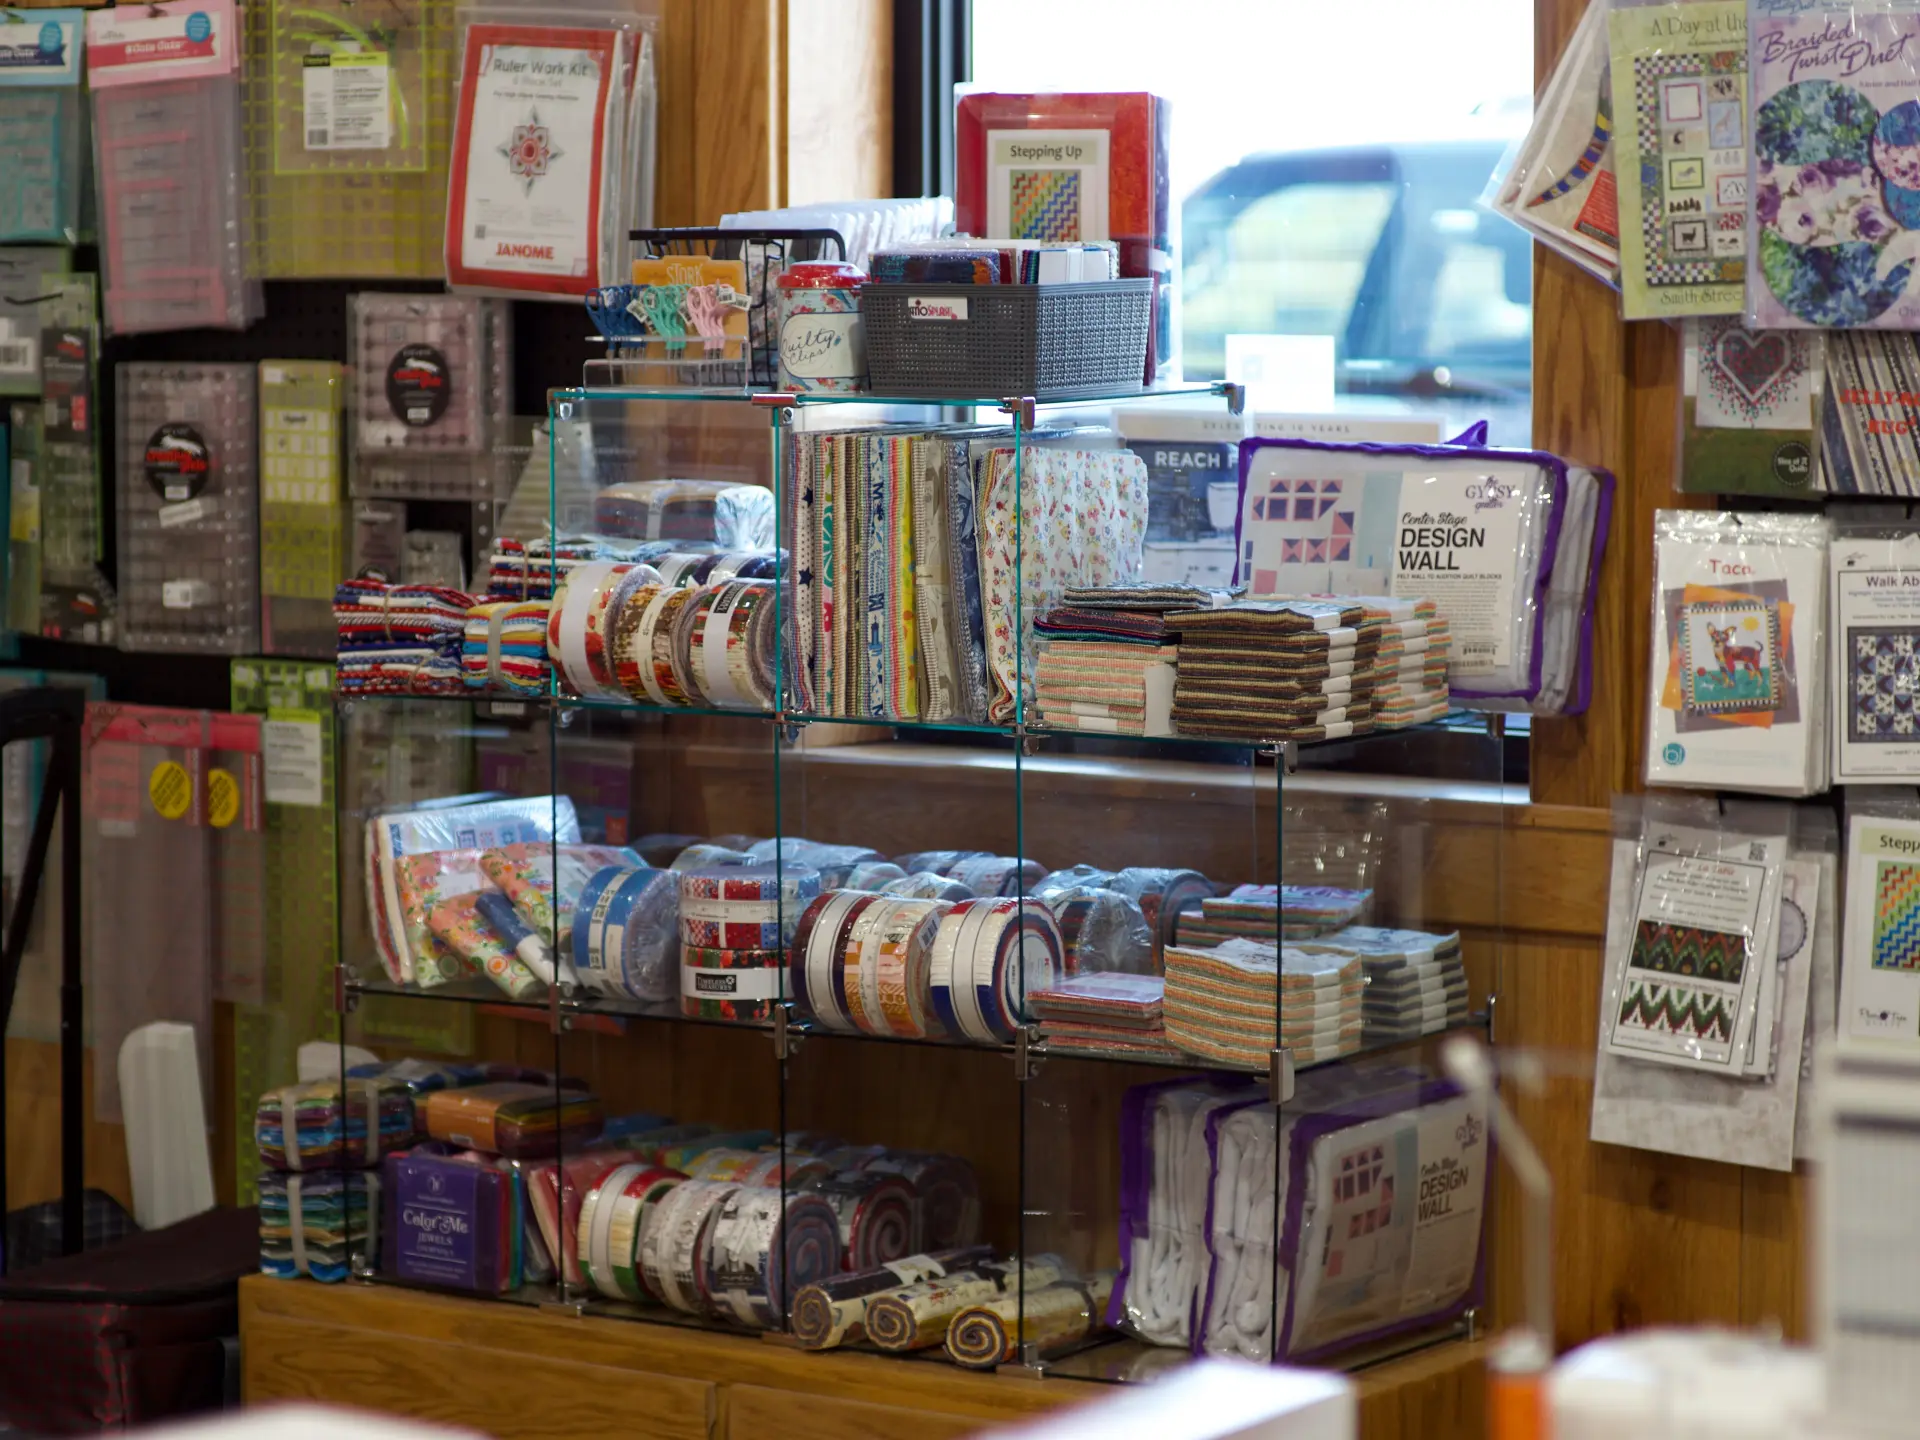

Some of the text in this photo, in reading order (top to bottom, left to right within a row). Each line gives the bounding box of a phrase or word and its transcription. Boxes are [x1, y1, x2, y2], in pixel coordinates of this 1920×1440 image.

[1667, 16, 1699, 37] Day
[1704, 17, 1721, 32] at
[1758, 20, 1854, 64] Braided
[493, 58, 588, 76] Ruler Work Kit
[1781, 33, 1915, 82] Twist Duet
[1010, 145, 1083, 161] Stepping Up
[496, 242, 554, 260] JANOME
[667, 263, 704, 286] STORK
[781, 328, 835, 359] Quilty
[1155, 451, 1221, 470] REACH
[1402, 512, 1467, 528] Center Stage
[1401, 527, 1485, 548] DESIGN
[1399, 550, 1460, 571] WALL
[1709, 558, 1751, 576] Taco
[1866, 575, 1897, 587] Walk
[1420, 1166, 1469, 1200] DESIGN
[403, 1207, 439, 1232] Color
[1418, 1196, 1453, 1223] WALL
